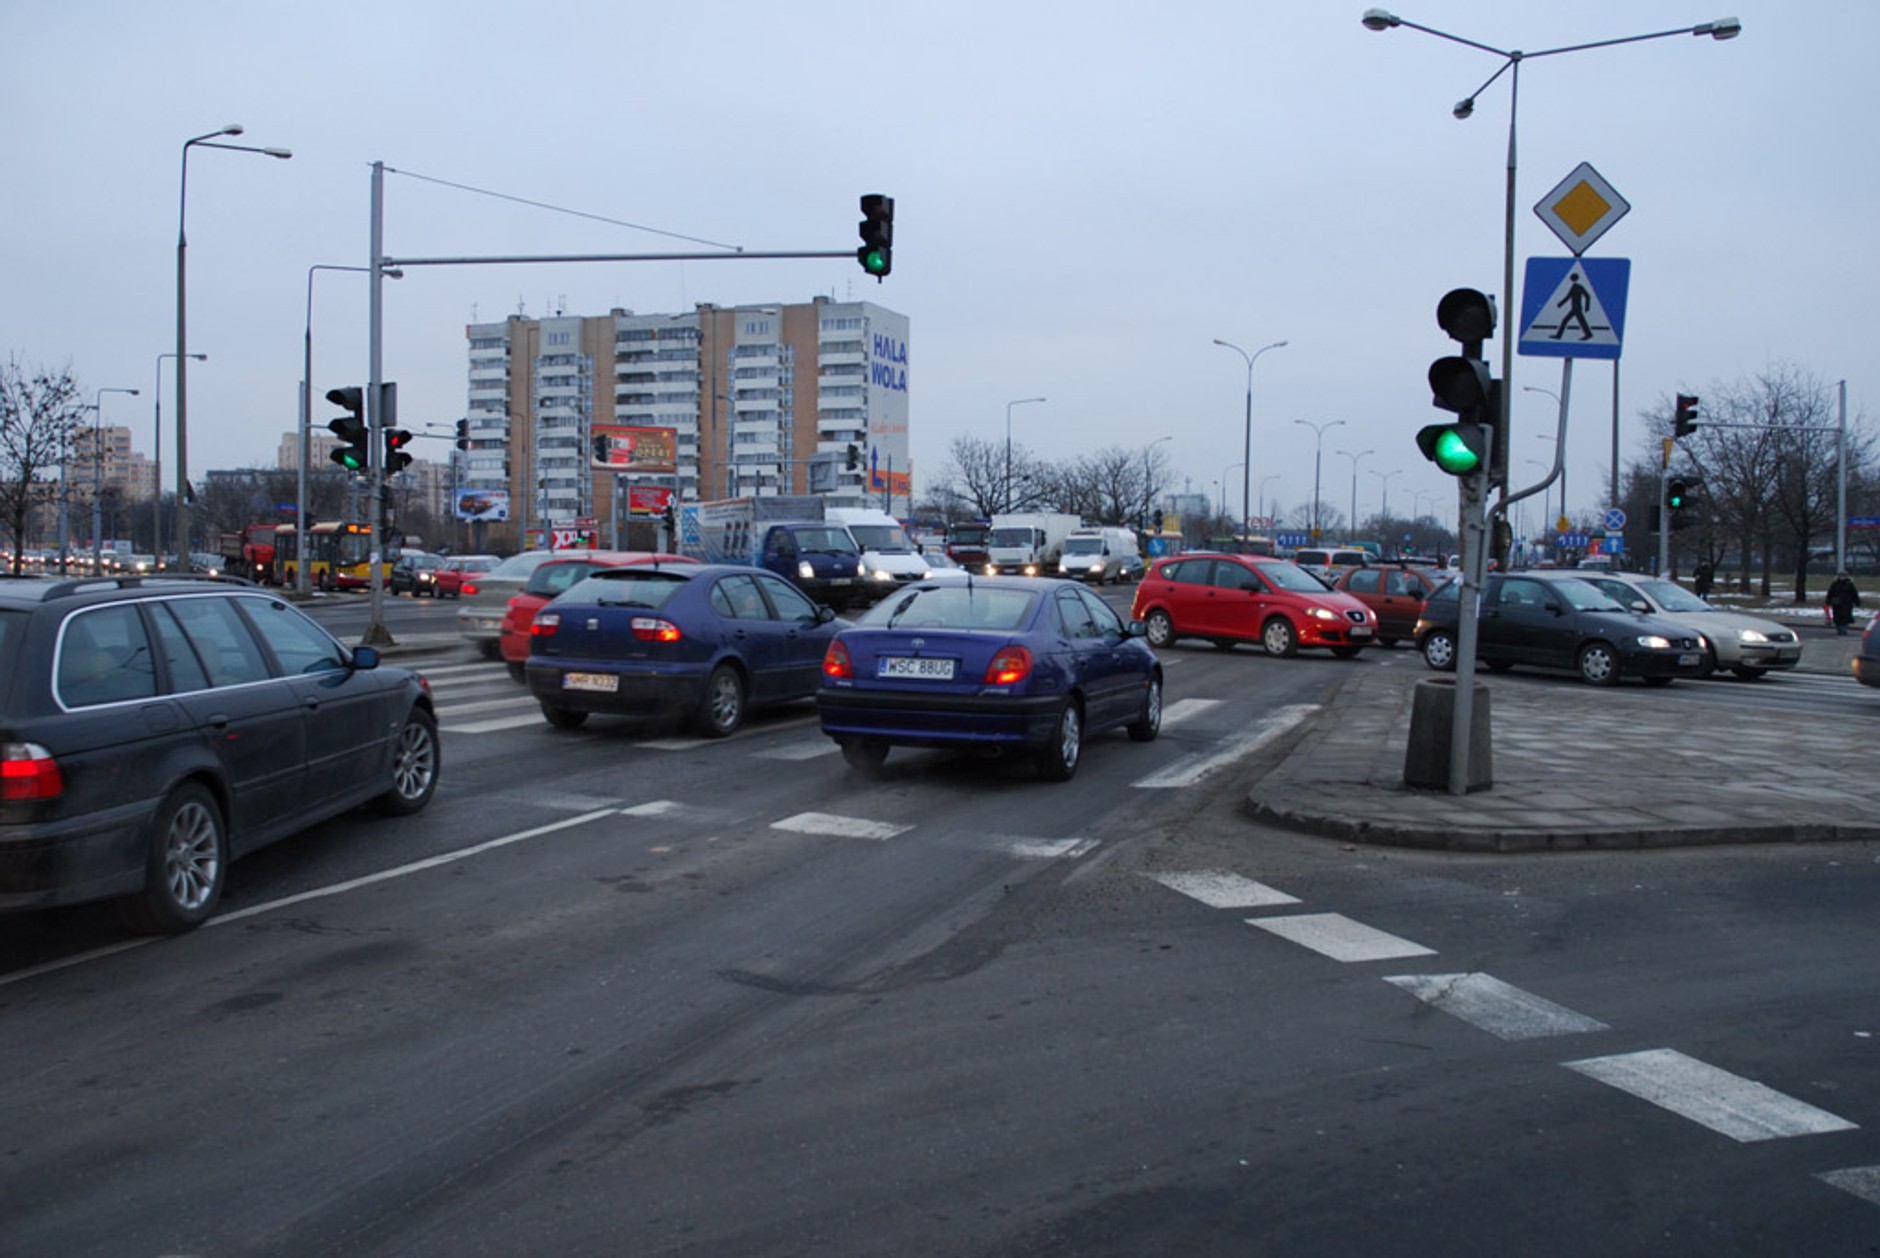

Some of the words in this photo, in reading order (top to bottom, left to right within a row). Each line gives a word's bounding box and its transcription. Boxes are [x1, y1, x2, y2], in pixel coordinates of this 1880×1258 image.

[873, 333, 907, 365] HALA
[871, 361, 907, 393] WOLA
[888, 659, 915, 674] WSC
